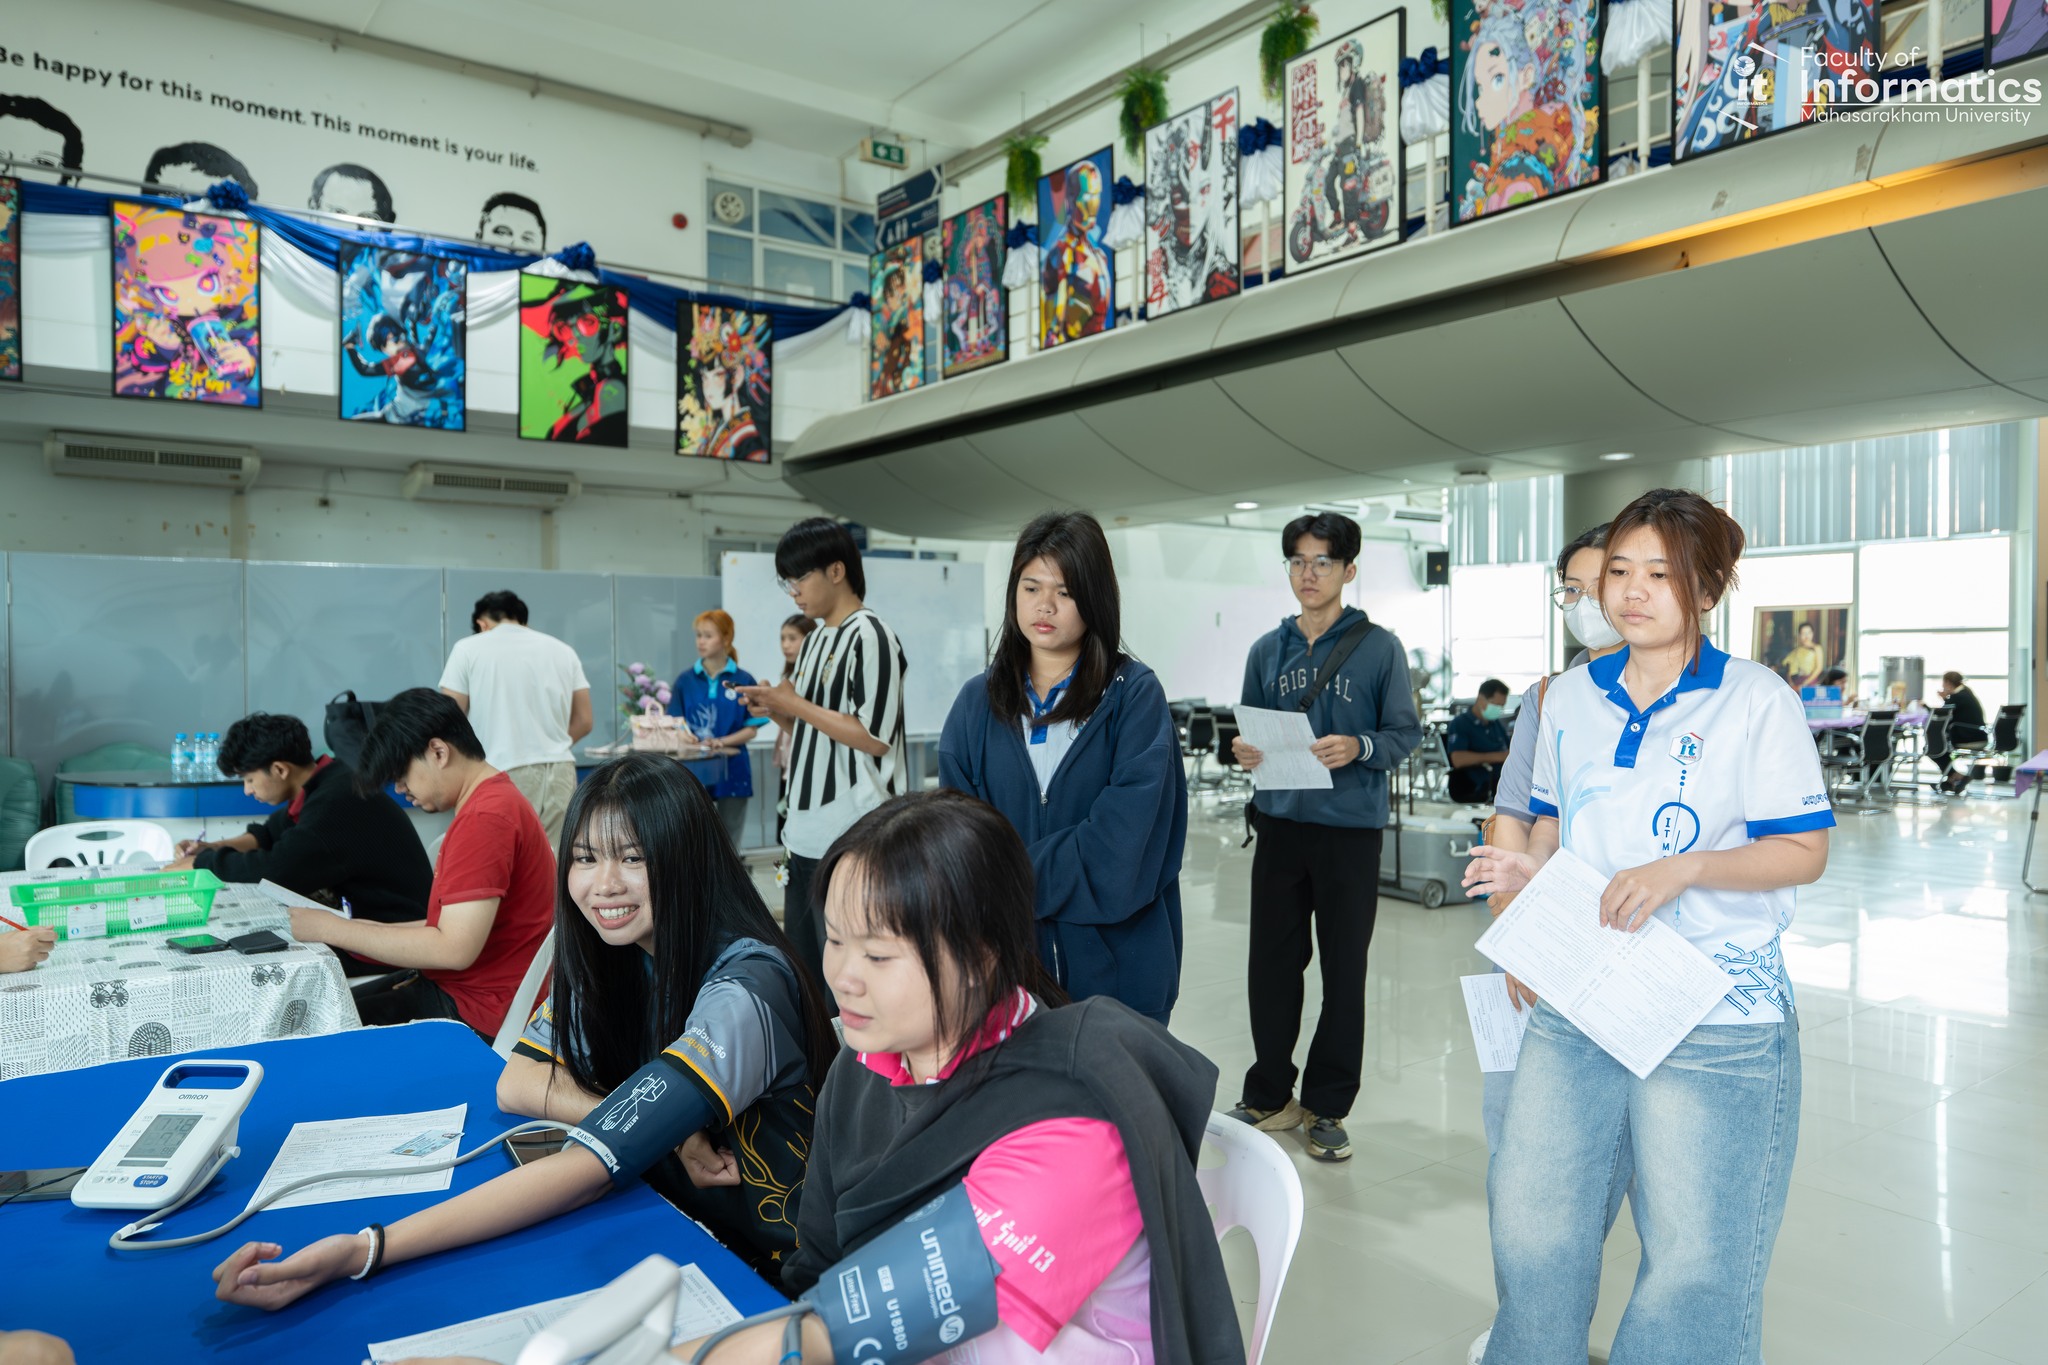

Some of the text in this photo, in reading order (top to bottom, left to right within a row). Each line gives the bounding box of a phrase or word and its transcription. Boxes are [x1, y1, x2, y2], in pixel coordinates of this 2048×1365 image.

[33, 52, 112, 88] happy
[118, 71, 153, 93] for
[159, 80, 203, 103] this
[210, 92, 307, 126] moment.
[310, 111, 352, 134] This
[357, 122, 440, 152] moment
[445, 138, 459, 155] is
[463, 145, 504, 165] your
[509, 152, 540, 173] life.
[1271, 667, 1352, 703] RIGIAL
[576, 1130, 615, 1165] RANGE MIN
[920, 1227, 961, 1316] unimed
[1028, 1246, 1056, 1273] 13
[886, 1297, 909, 1351] U1880D
